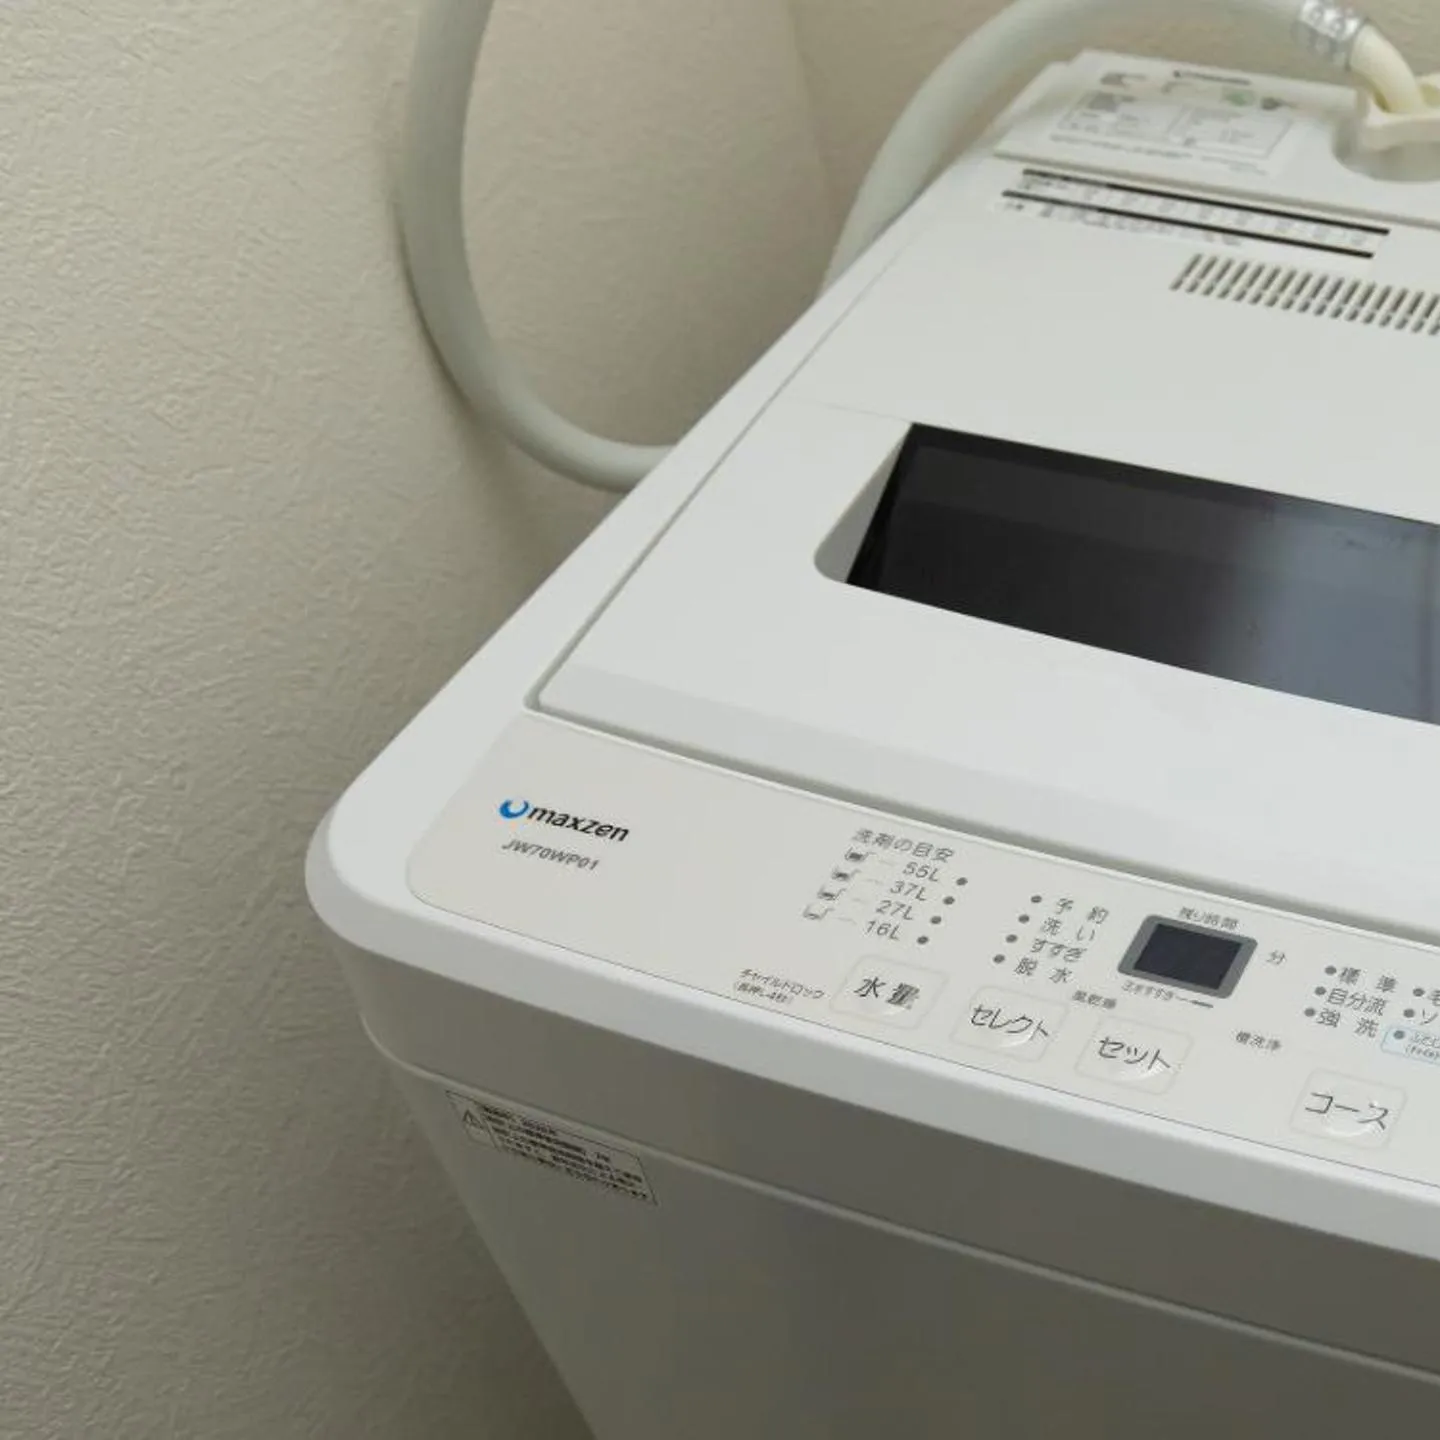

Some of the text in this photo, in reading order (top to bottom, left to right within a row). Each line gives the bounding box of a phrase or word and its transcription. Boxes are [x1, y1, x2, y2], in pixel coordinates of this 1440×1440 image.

[527, 806, 630, 842] maxzen
[502, 839, 600, 870] JW70WP01
[853, 828, 955, 862] 洗剤の目安
[903, 861, 939, 882] 55L
[890, 881, 927, 901] 37L
[876, 900, 913, 921] 27L
[866, 920, 900, 940] 16L
[1031, 938, 1087, 963] すすぎ
[1328, 988, 1387, 1016] 自分流
[970, 1003, 1051, 1041] セレクト
[1098, 1036, 1171, 1071] セット
[1305, 1091, 1389, 1129] コース
